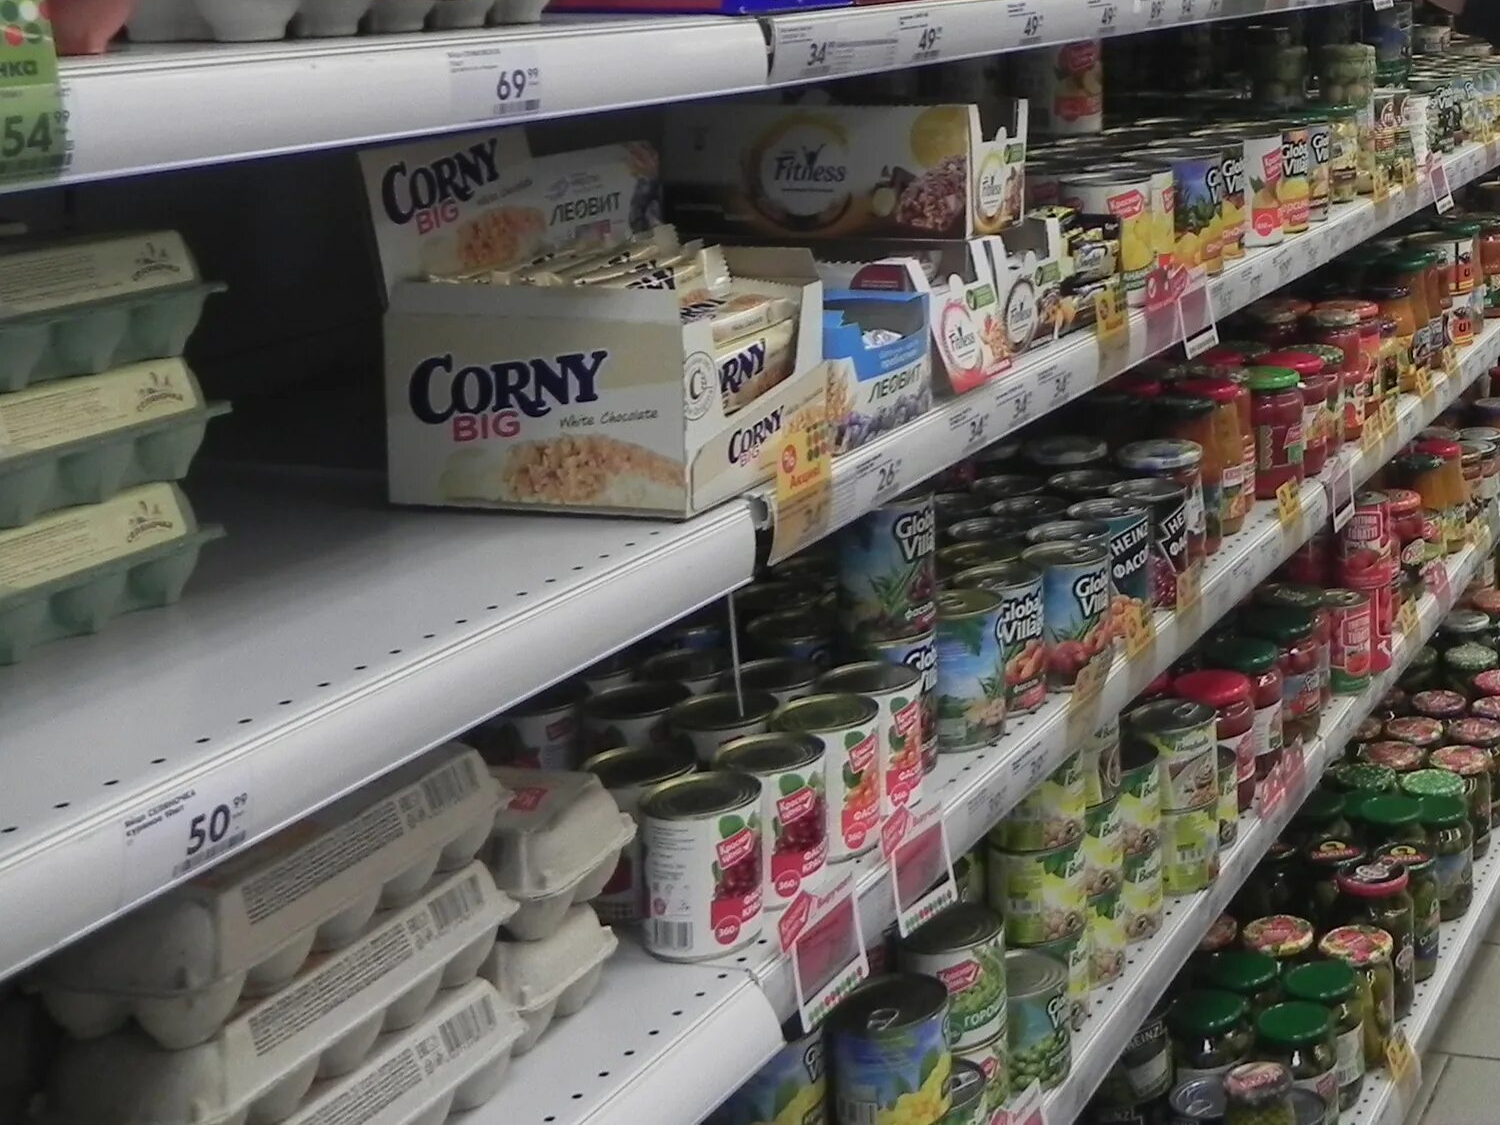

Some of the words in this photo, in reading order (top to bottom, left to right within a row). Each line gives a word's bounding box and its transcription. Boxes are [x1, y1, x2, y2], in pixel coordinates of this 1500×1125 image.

[918, 27, 936, 51] 49
[1024, 14, 1039, 38] 49
[806, 41, 829, 66] 34
[497, 68, 526, 101] 69
[2, 112, 53, 158] 54
[381, 137, 499, 226] CORNY
[773, 155, 847, 183] Fitness
[415, 199, 460, 236] BIG
[550, 191, 621, 226] ЛЕОВИТ
[718, 338, 767, 395] RNY
[866, 363, 923, 404] ЛЕОВИТ
[409, 350, 608, 425] CORNY
[453, 410, 521, 443] BIG
[560, 414, 595, 429] White
[600, 407, 659, 426] Chocolate
[728, 405, 785, 466] CORNY
[877, 464, 895, 493] 26
[186, 803, 231, 856] 50
